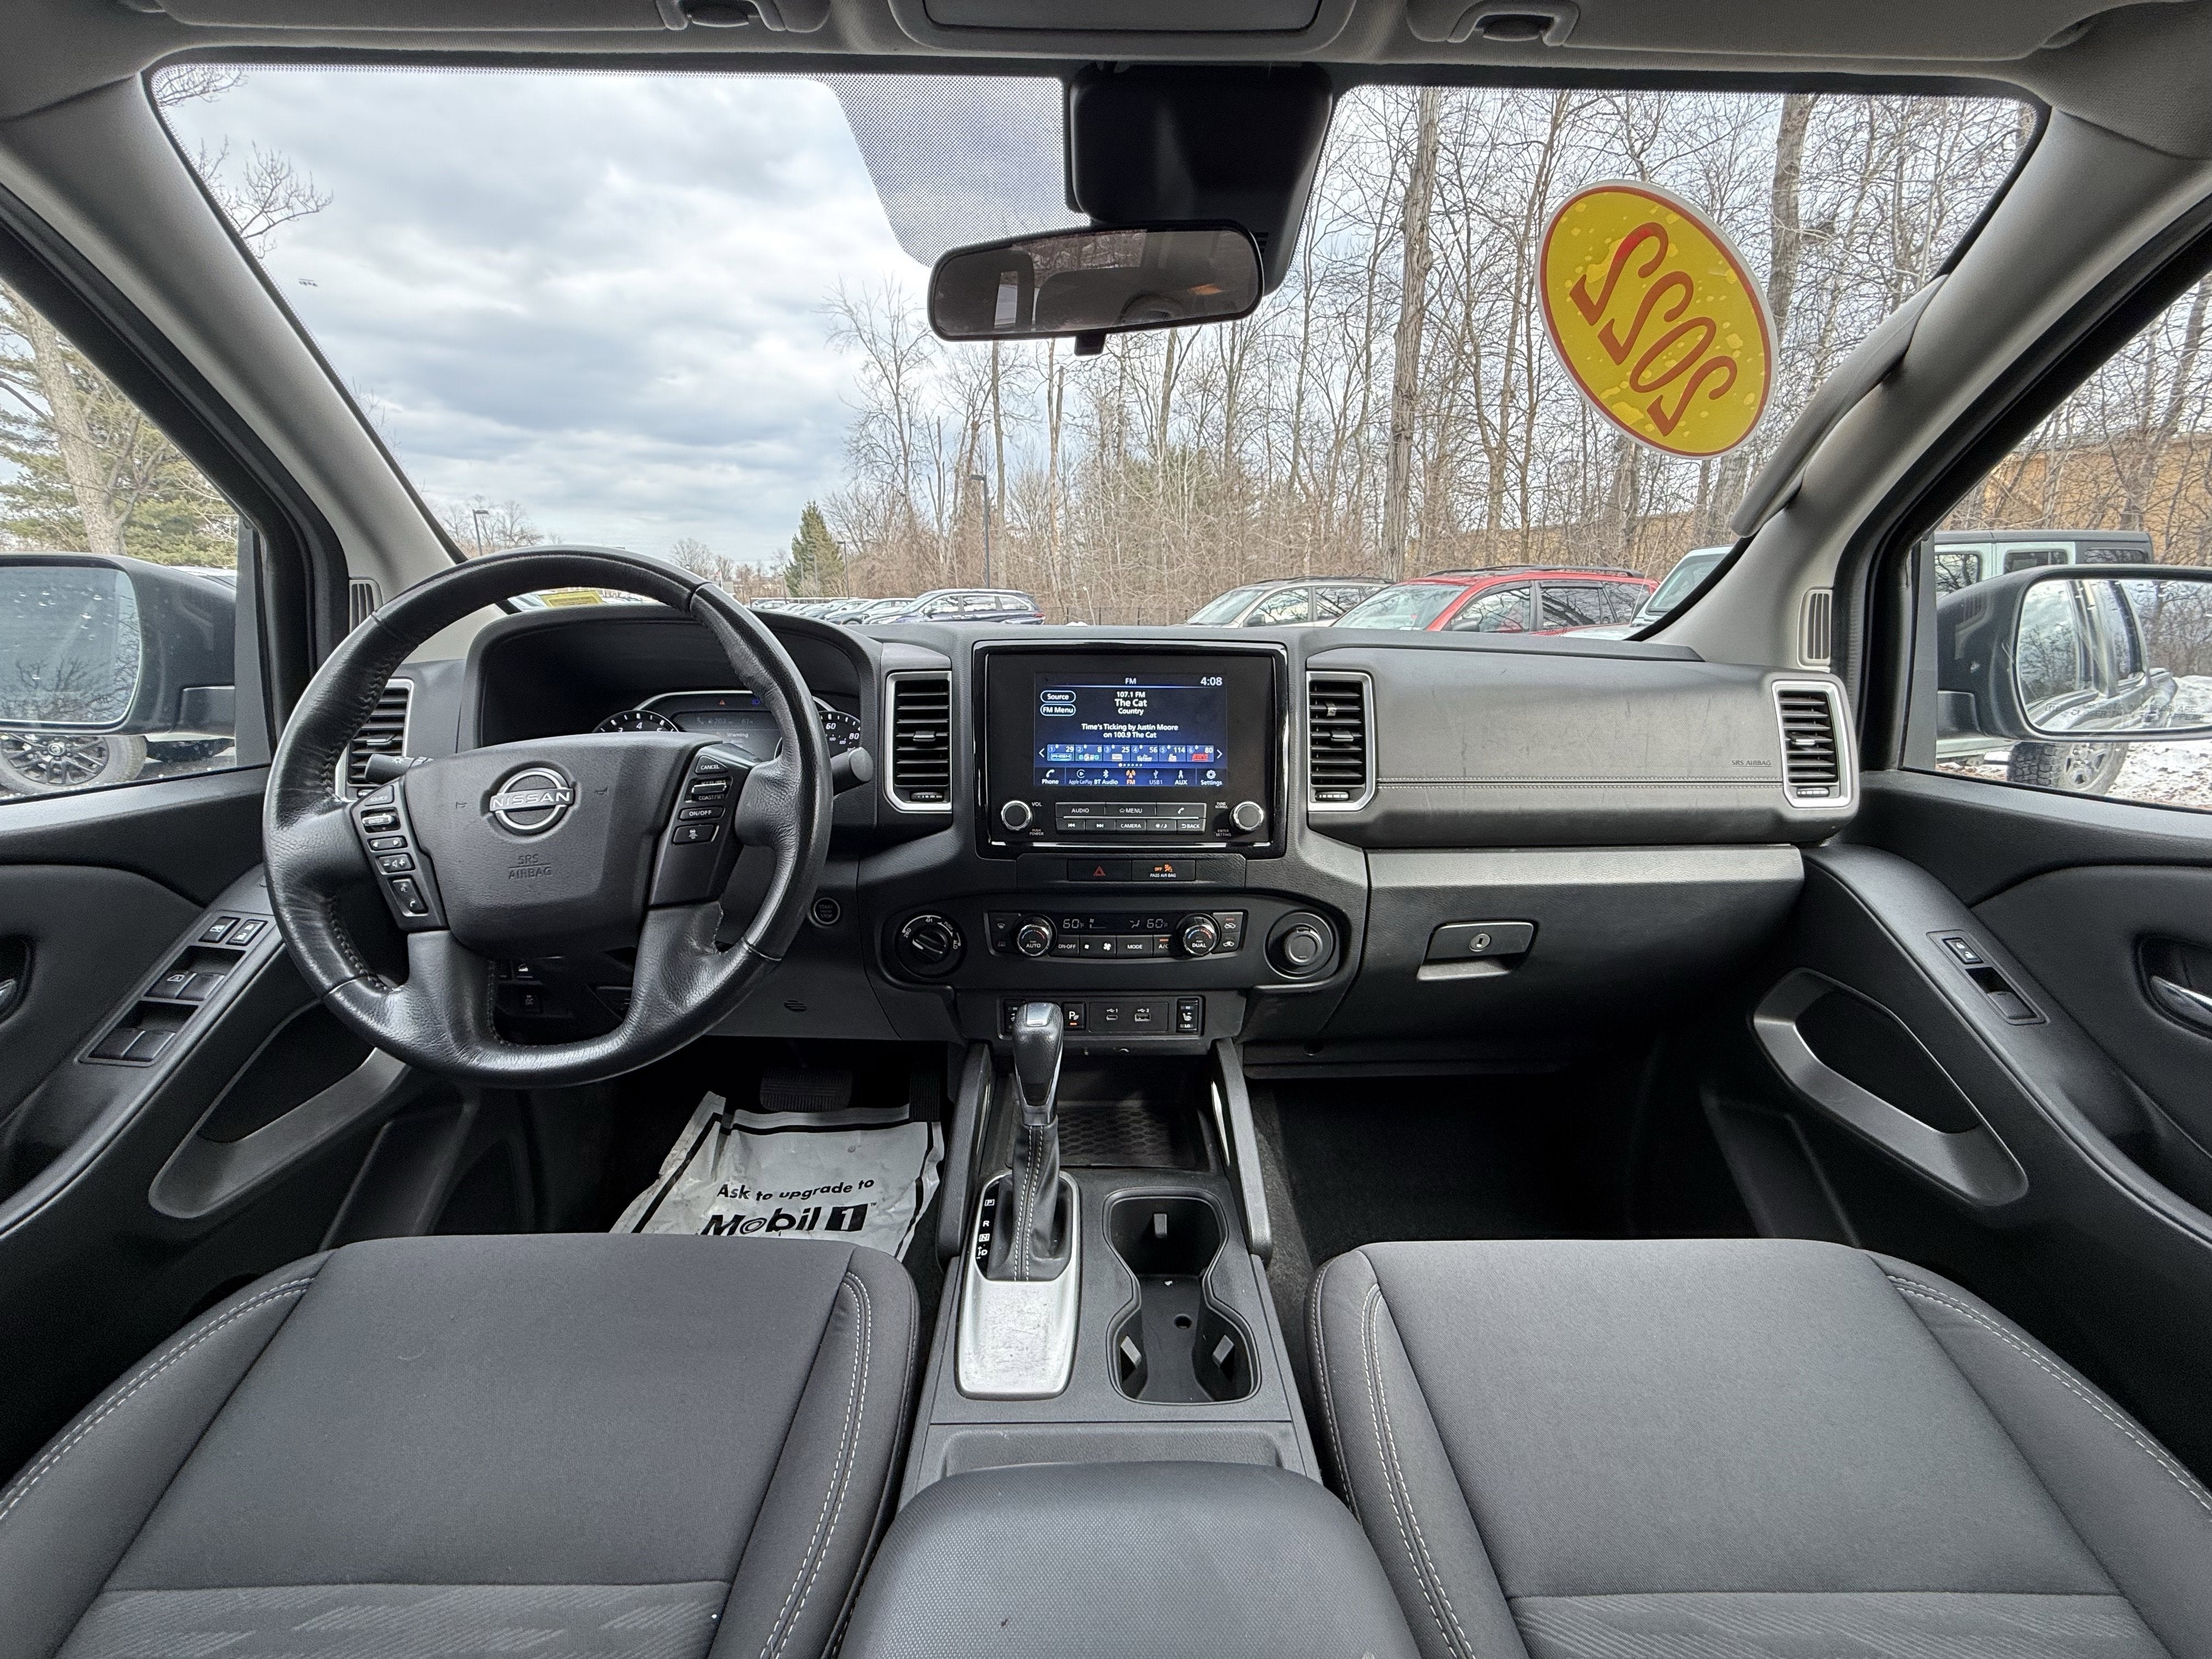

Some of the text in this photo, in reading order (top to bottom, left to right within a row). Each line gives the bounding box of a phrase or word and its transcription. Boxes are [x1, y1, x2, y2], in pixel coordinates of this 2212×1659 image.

[1200, 676, 1223, 686] 4:08
[1114, 698, 1147, 707] The Cat
[1118, 708, 1144, 716] Country
[1103, 723, 1127, 731] Ticking
[1128, 723, 1137, 732] by
[492, 791, 570, 809] NISSAN
[518, 854, 539, 865] SRS
[508, 867, 552, 879] AIRBAG
[716, 1179, 874, 1201] Ask to upgrade to
[700, 1206, 822, 1236] Mobil
